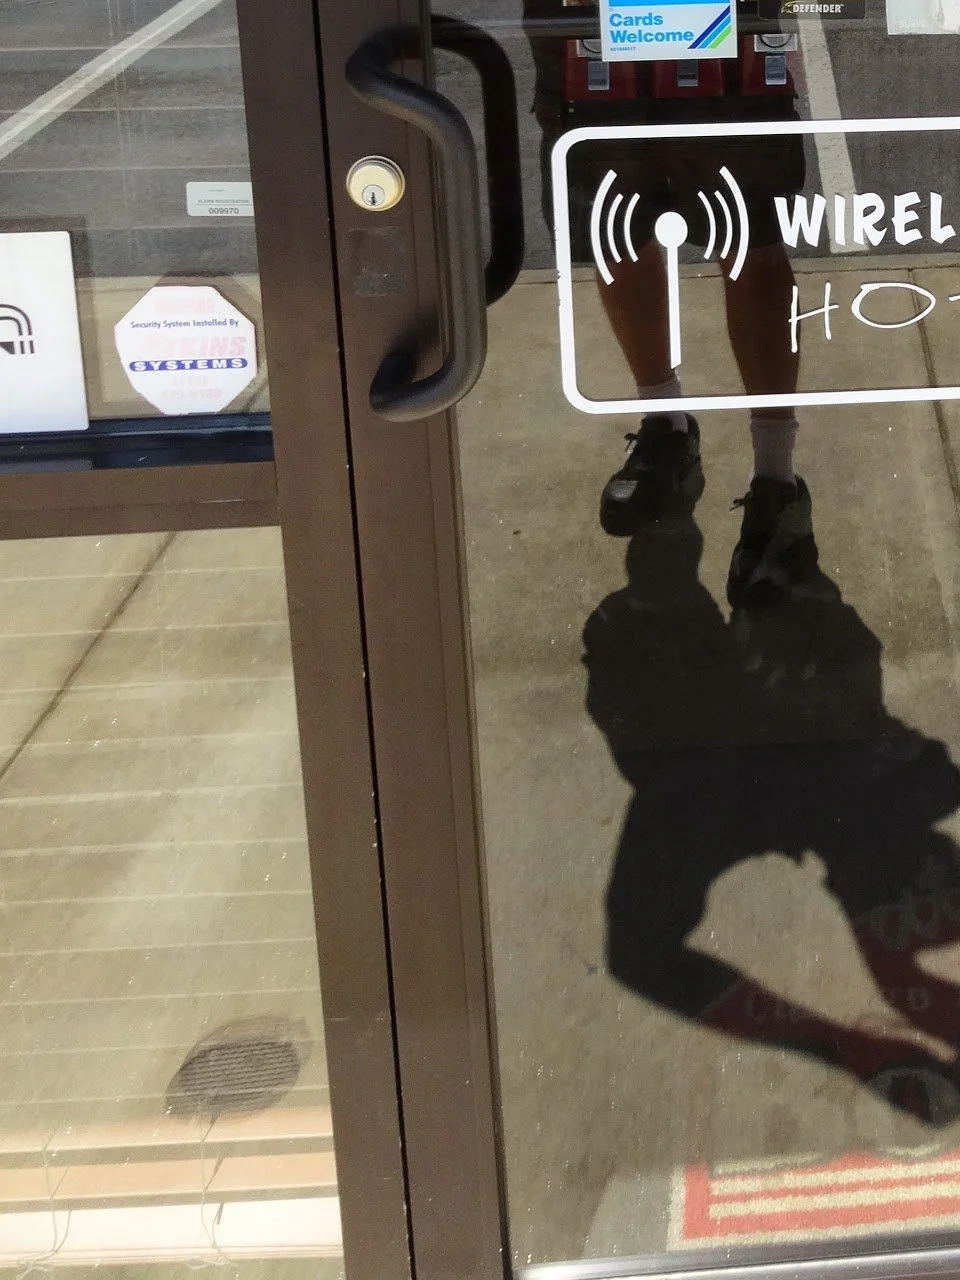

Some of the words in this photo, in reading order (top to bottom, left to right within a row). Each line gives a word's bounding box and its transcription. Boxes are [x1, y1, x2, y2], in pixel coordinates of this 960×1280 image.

[792, 1, 842, 14] DEFENDER
[609, 12, 664, 28] Cards
[609, 28, 695, 44] Welcome
[208, 207, 240, 215] 009970
[130, 320, 161, 329] Security
[162, 320, 190, 329] System
[192, 318, 227, 327] Installed
[229, 318, 239, 327] By
[134, 358, 244, 372] SYSTEMS
